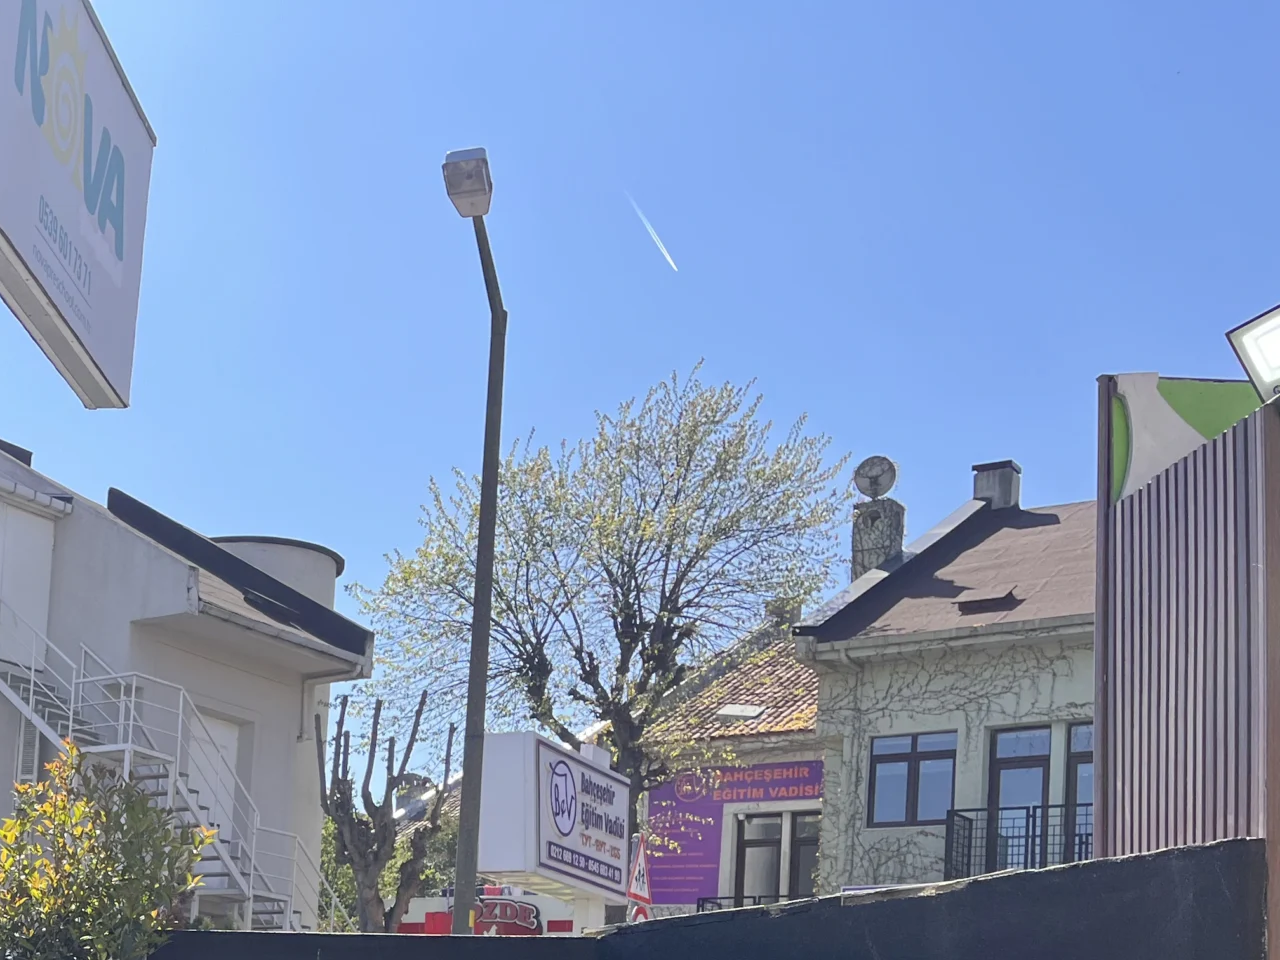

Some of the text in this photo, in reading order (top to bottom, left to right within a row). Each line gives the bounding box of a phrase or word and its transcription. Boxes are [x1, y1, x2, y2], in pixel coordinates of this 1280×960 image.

[14, 0, 125, 262] NOVA
[39, 194, 91, 296] 0539 601 73 71
[581, 772, 615, 806] Bahçeşehir
[713, 782, 819, 801] EĞİTİM VADİSİ
[581, 802, 625, 840] Eğitim Vadisi
[550, 844, 562, 860] 0212
[474, 898, 537, 929] ZDE
